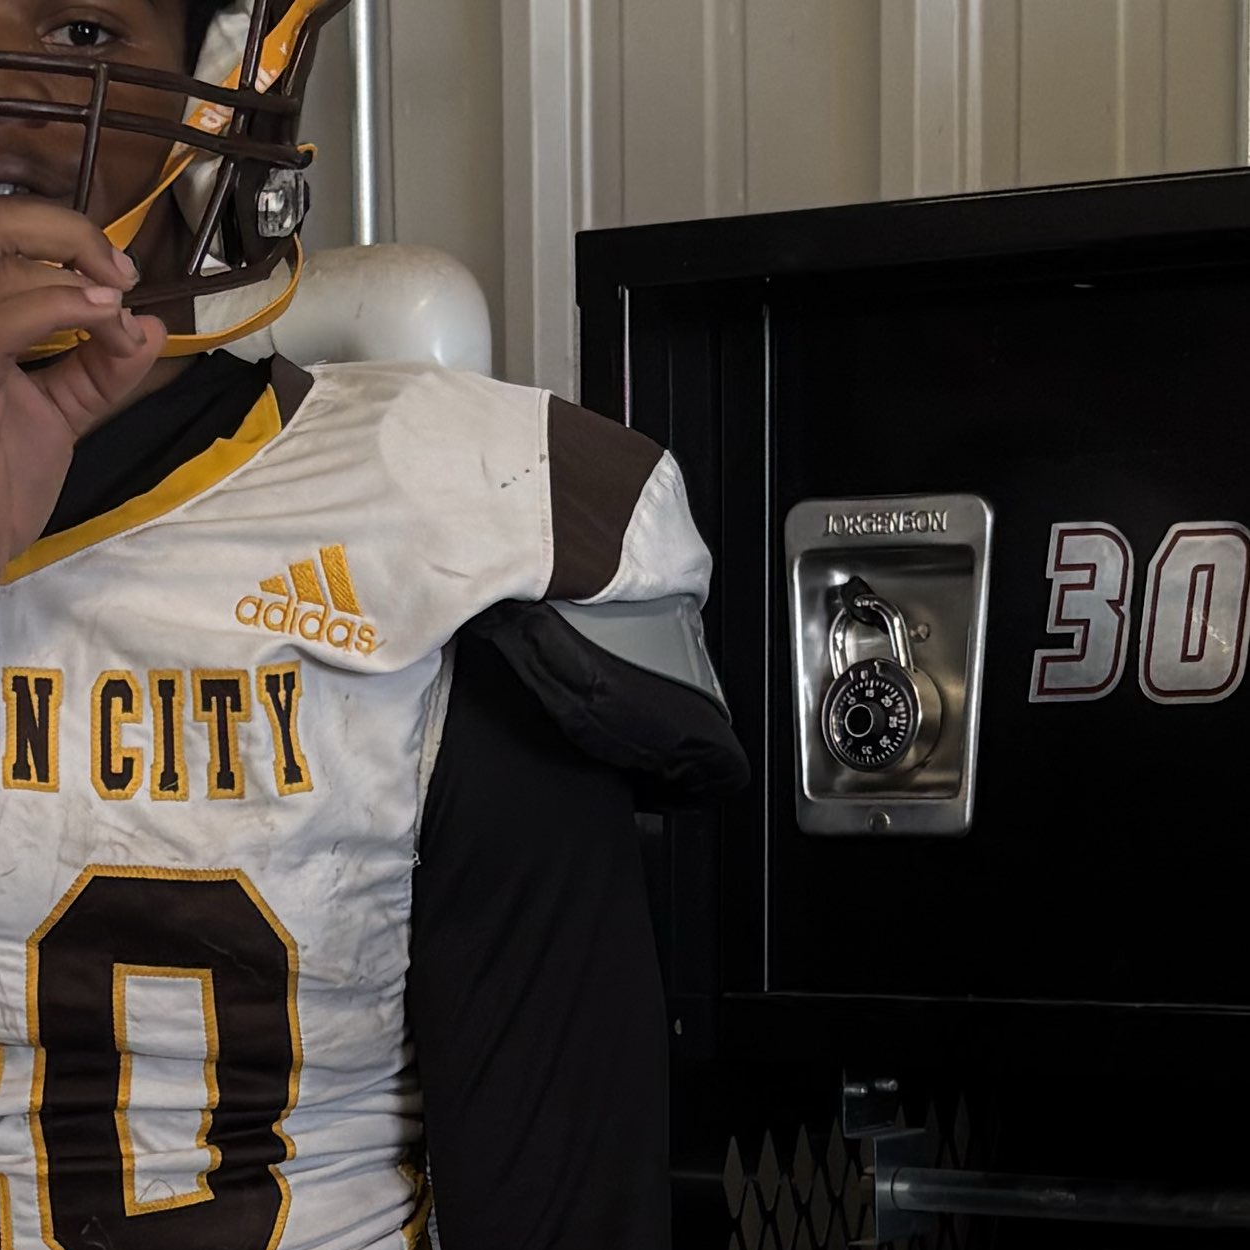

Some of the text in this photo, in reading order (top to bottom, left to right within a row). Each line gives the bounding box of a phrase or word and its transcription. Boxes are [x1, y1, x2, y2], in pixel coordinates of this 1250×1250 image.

[823, 511, 947, 536] JORGENSON
[236, 594, 378, 656] adidas
[1029, 521, 1250, 704] 30
[90, 660, 314, 802] CITY
